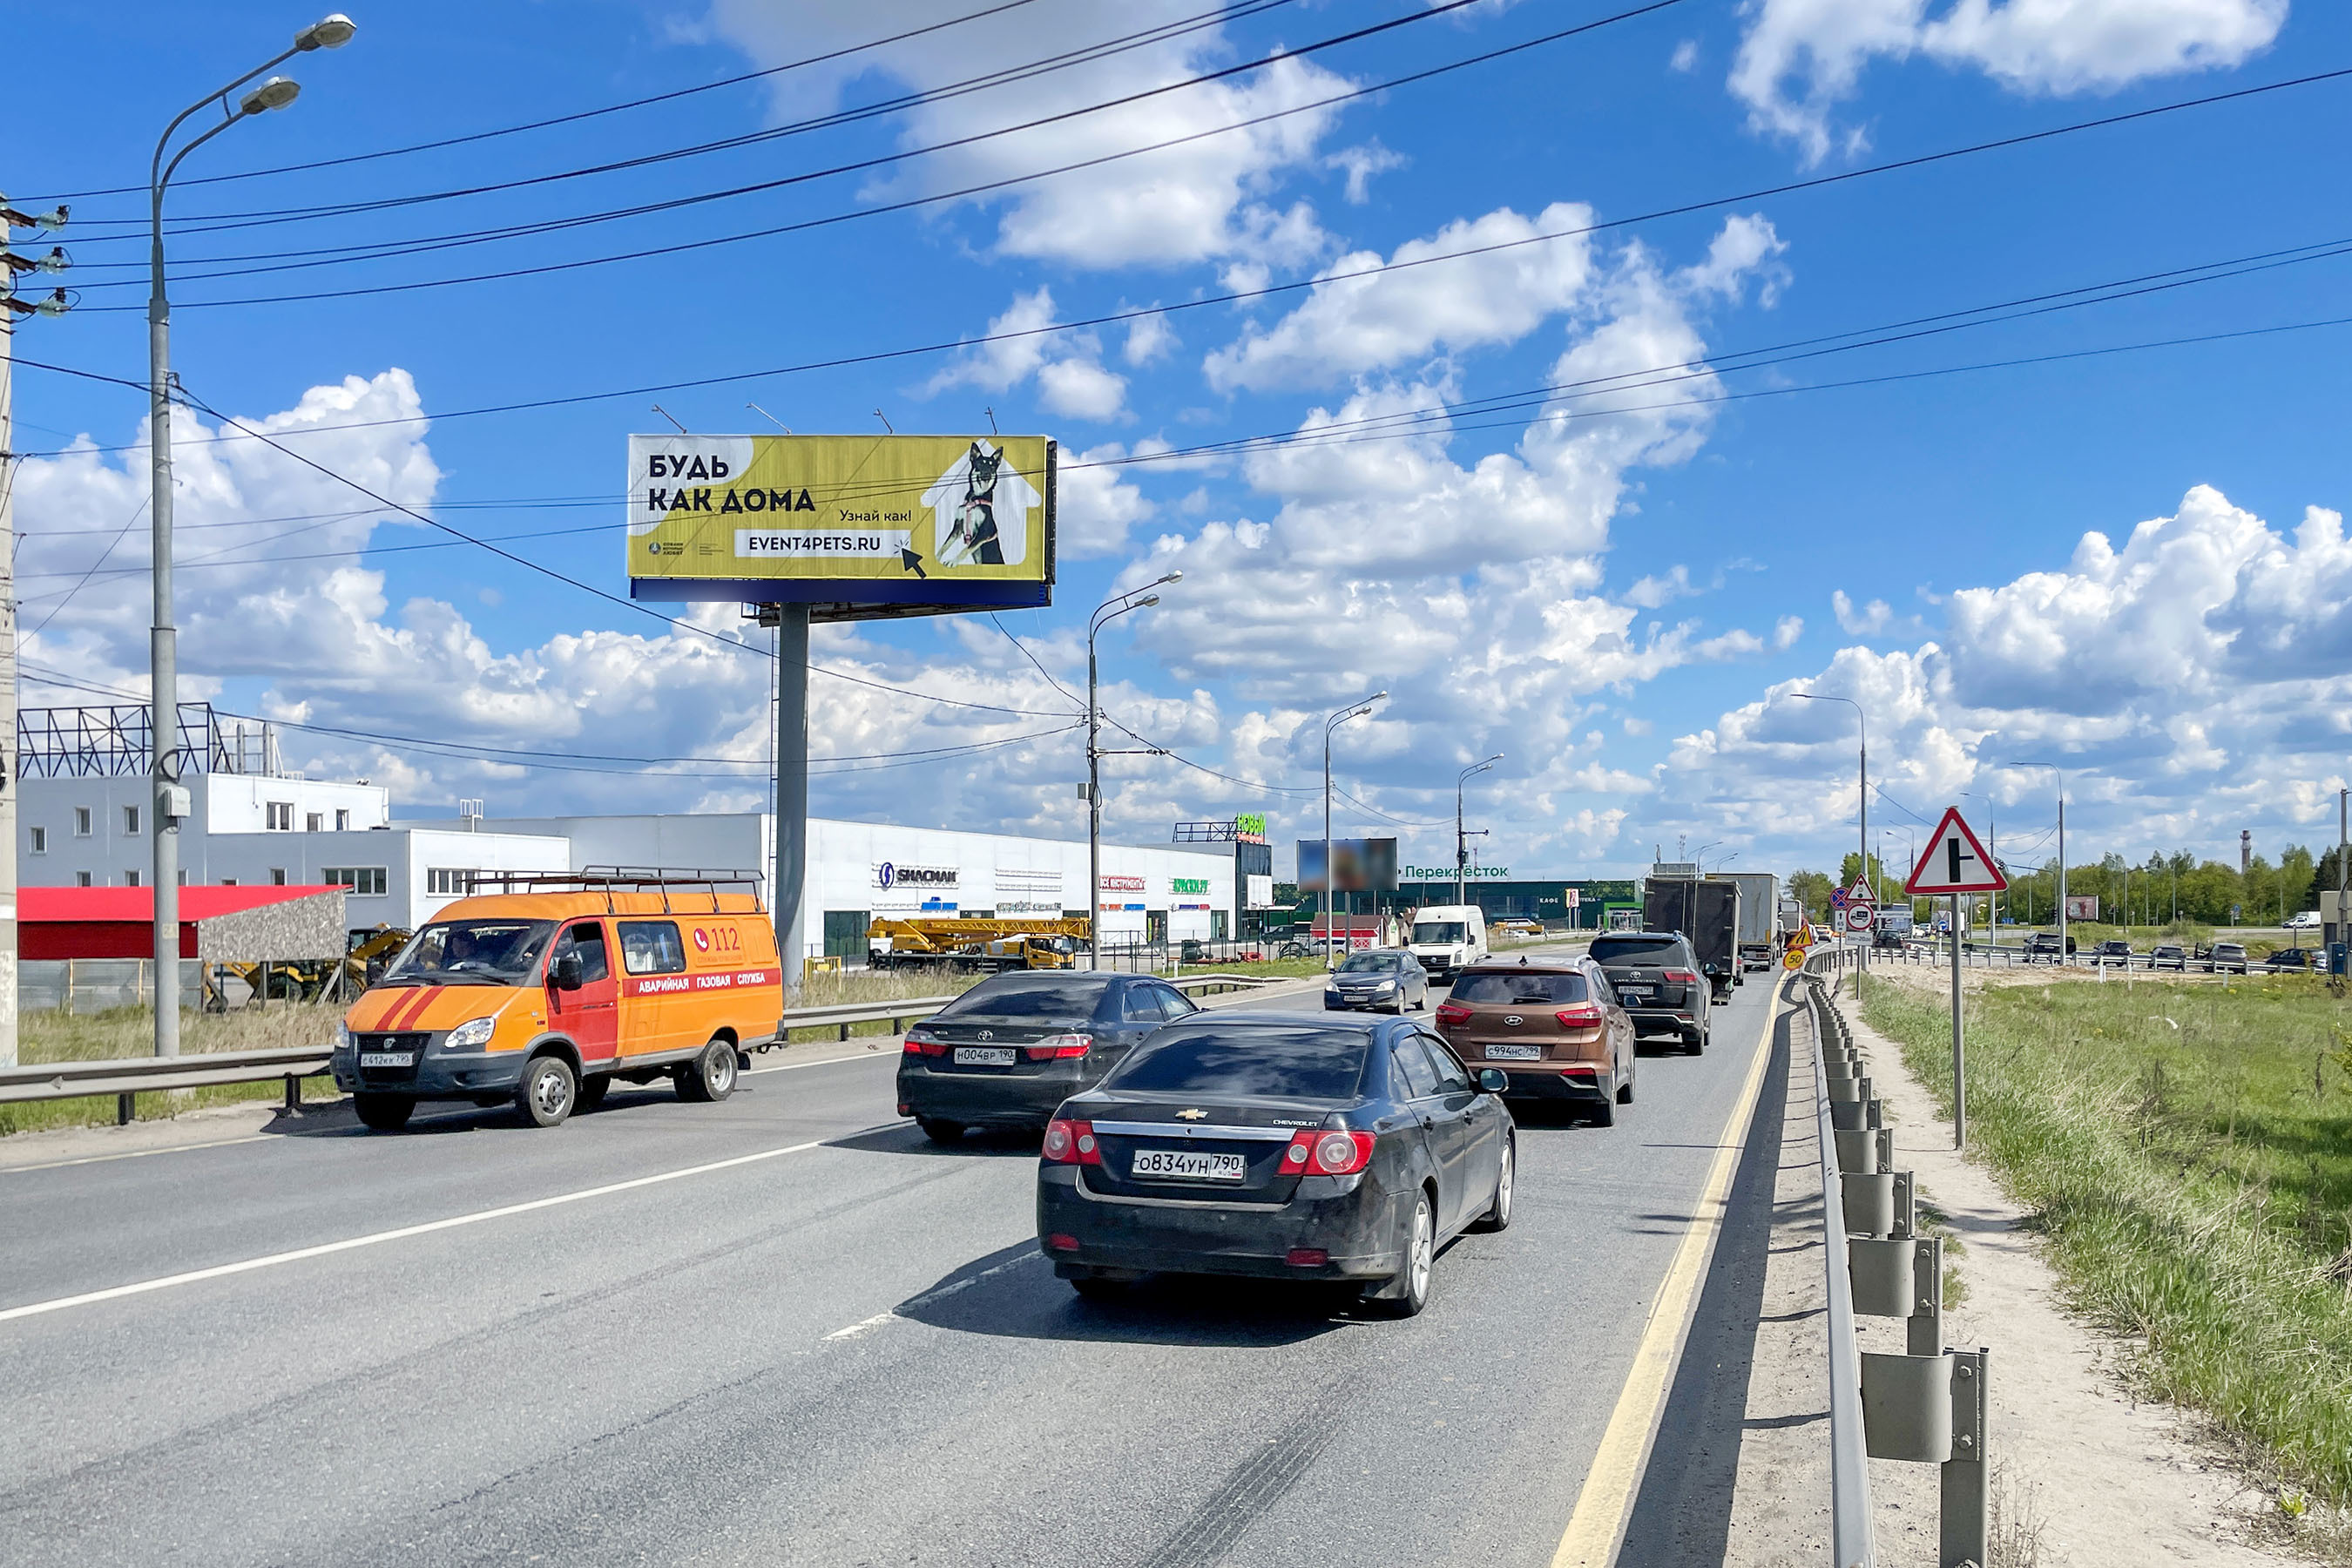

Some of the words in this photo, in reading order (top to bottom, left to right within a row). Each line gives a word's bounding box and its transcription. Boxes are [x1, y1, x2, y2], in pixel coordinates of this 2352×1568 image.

[649, 454, 729, 480] БУДЬ
[648, 488, 713, 511] КАК
[720, 488, 816, 514] ДОМА
[840, 510, 880, 522] Узнай
[884, 510, 912, 522] как!
[749, 537, 881, 551] EVENT4PETS.RU
[896, 868, 956, 882] SHACMAN
[1405, 865, 1509, 881] Перекрёсток
[712, 928, 740, 951] 112
[1788, 955, 1802, 963] 50
[639, 977, 689, 993] АВАРИЙНАЯ
[697, 974, 731, 989] ГАЗОВАЯ
[737, 972, 766, 985] СЛУЖБА
[1213, 1155, 1240, 1171] 790
